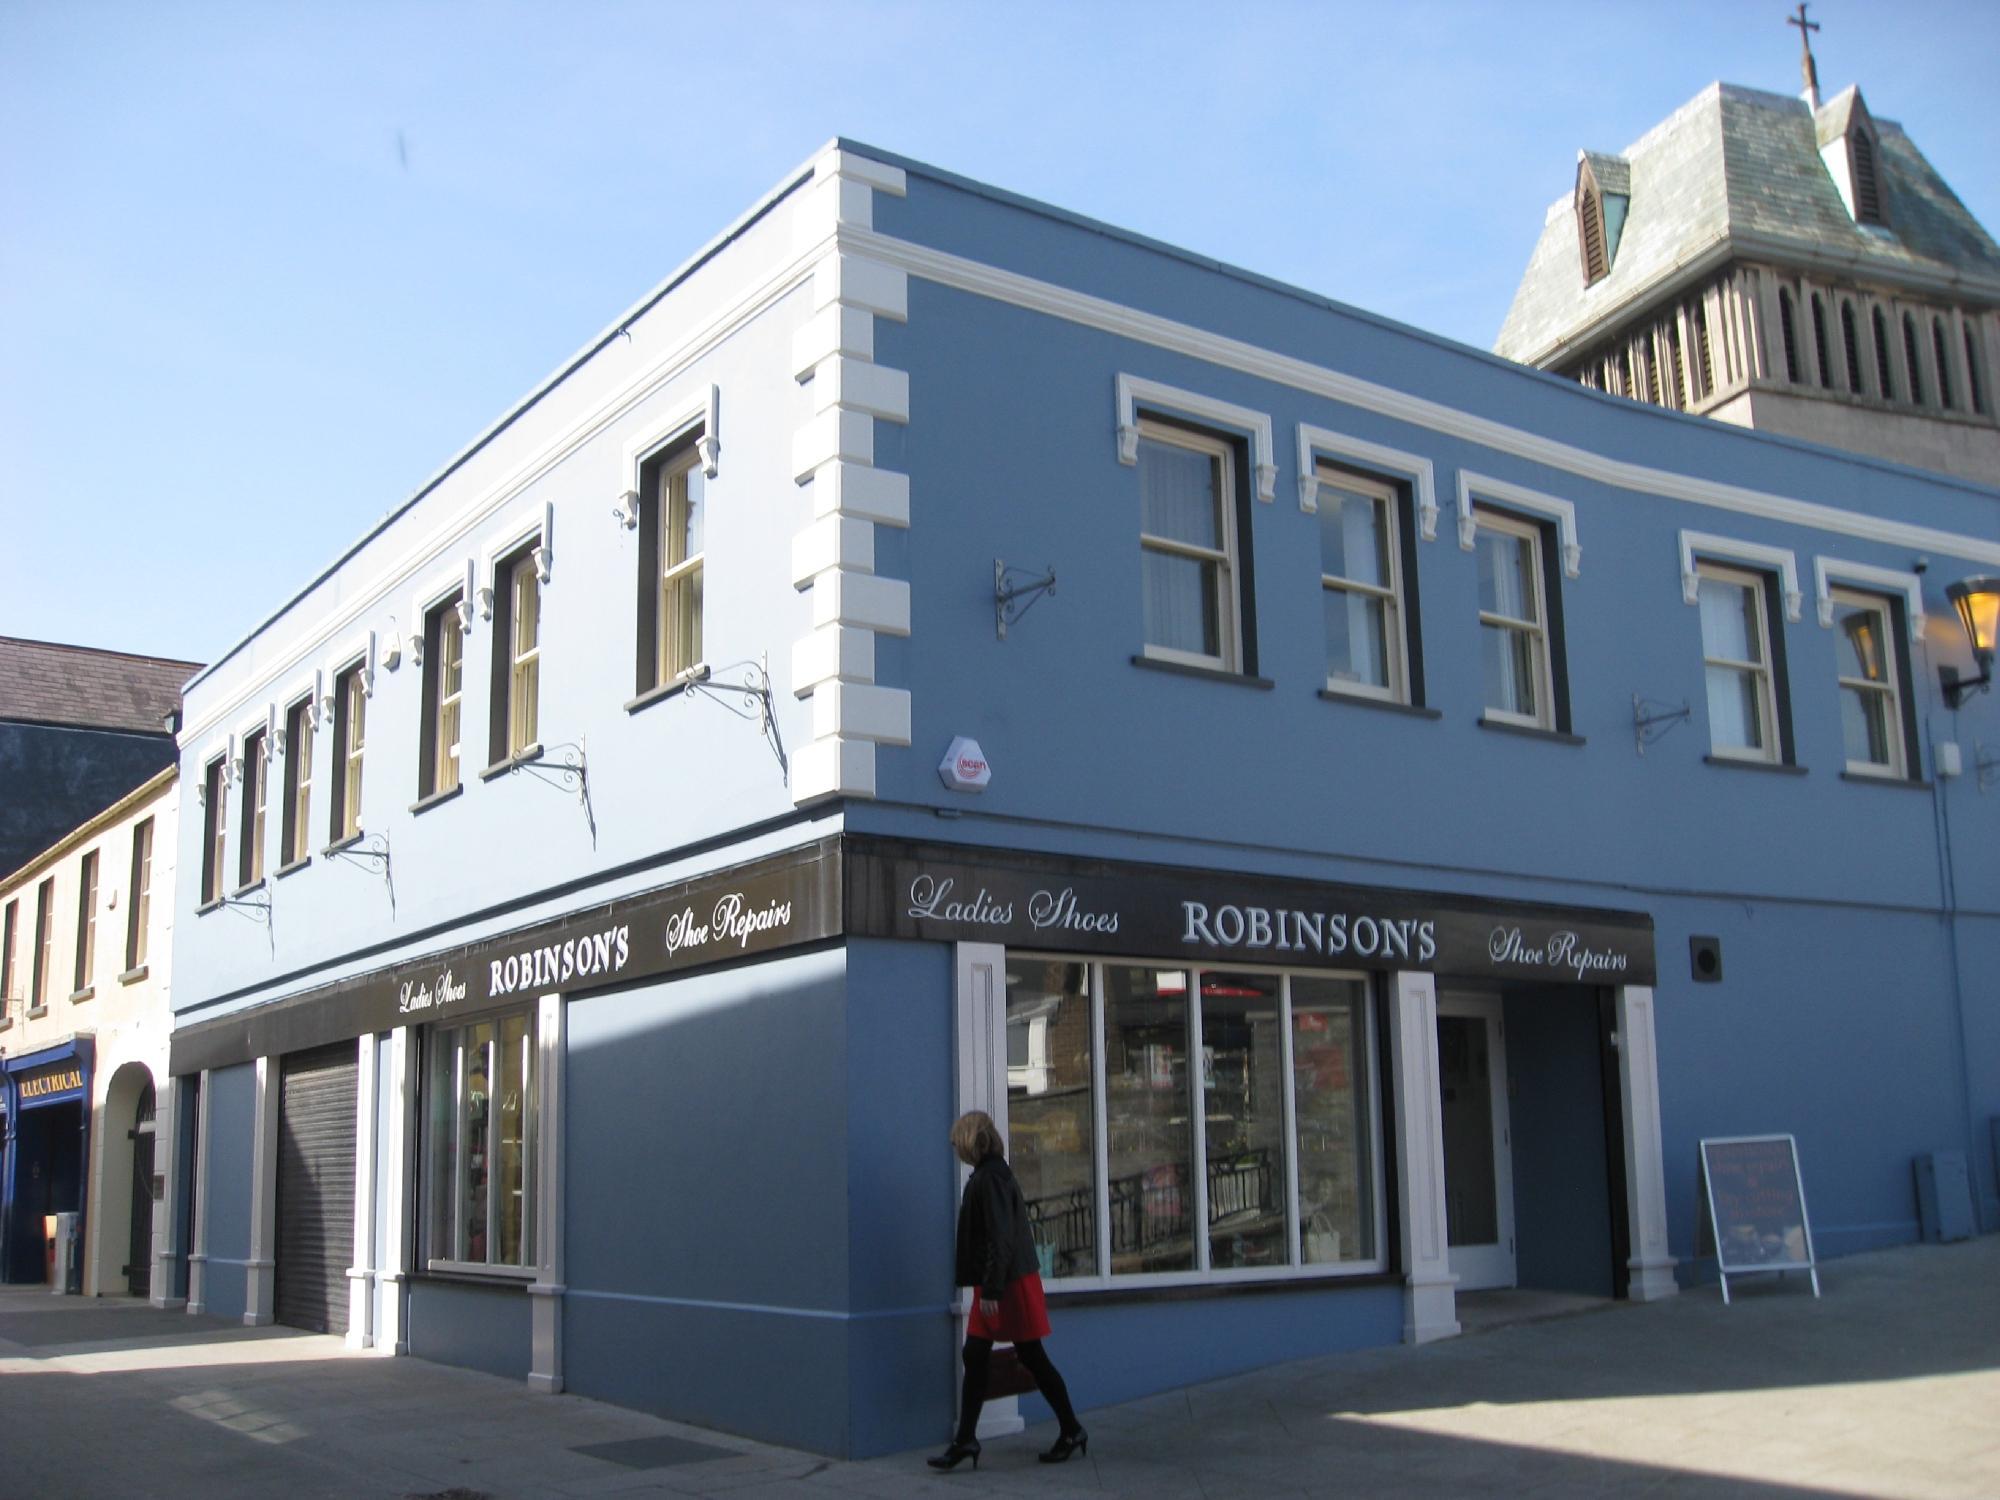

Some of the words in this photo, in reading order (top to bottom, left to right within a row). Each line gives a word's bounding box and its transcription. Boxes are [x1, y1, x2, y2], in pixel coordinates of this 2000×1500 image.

[666, 906, 709, 958] Shoe
[712, 892, 792, 949] Repairs
[908, 873, 1013, 926] Ladies
[1028, 887, 1120, 935] Shoes
[1181, 900, 1437, 962] ROBINSON'S
[488, 924, 630, 997] ROBINSON'S
[1487, 925, 1544, 967] Shoe
[1547, 928, 1628, 981] Repairs
[399, 978, 433, 1014] Ladies
[435, 968, 467, 1010] Shoes
[20, 1070, 83, 1098] ELECTRICAL
